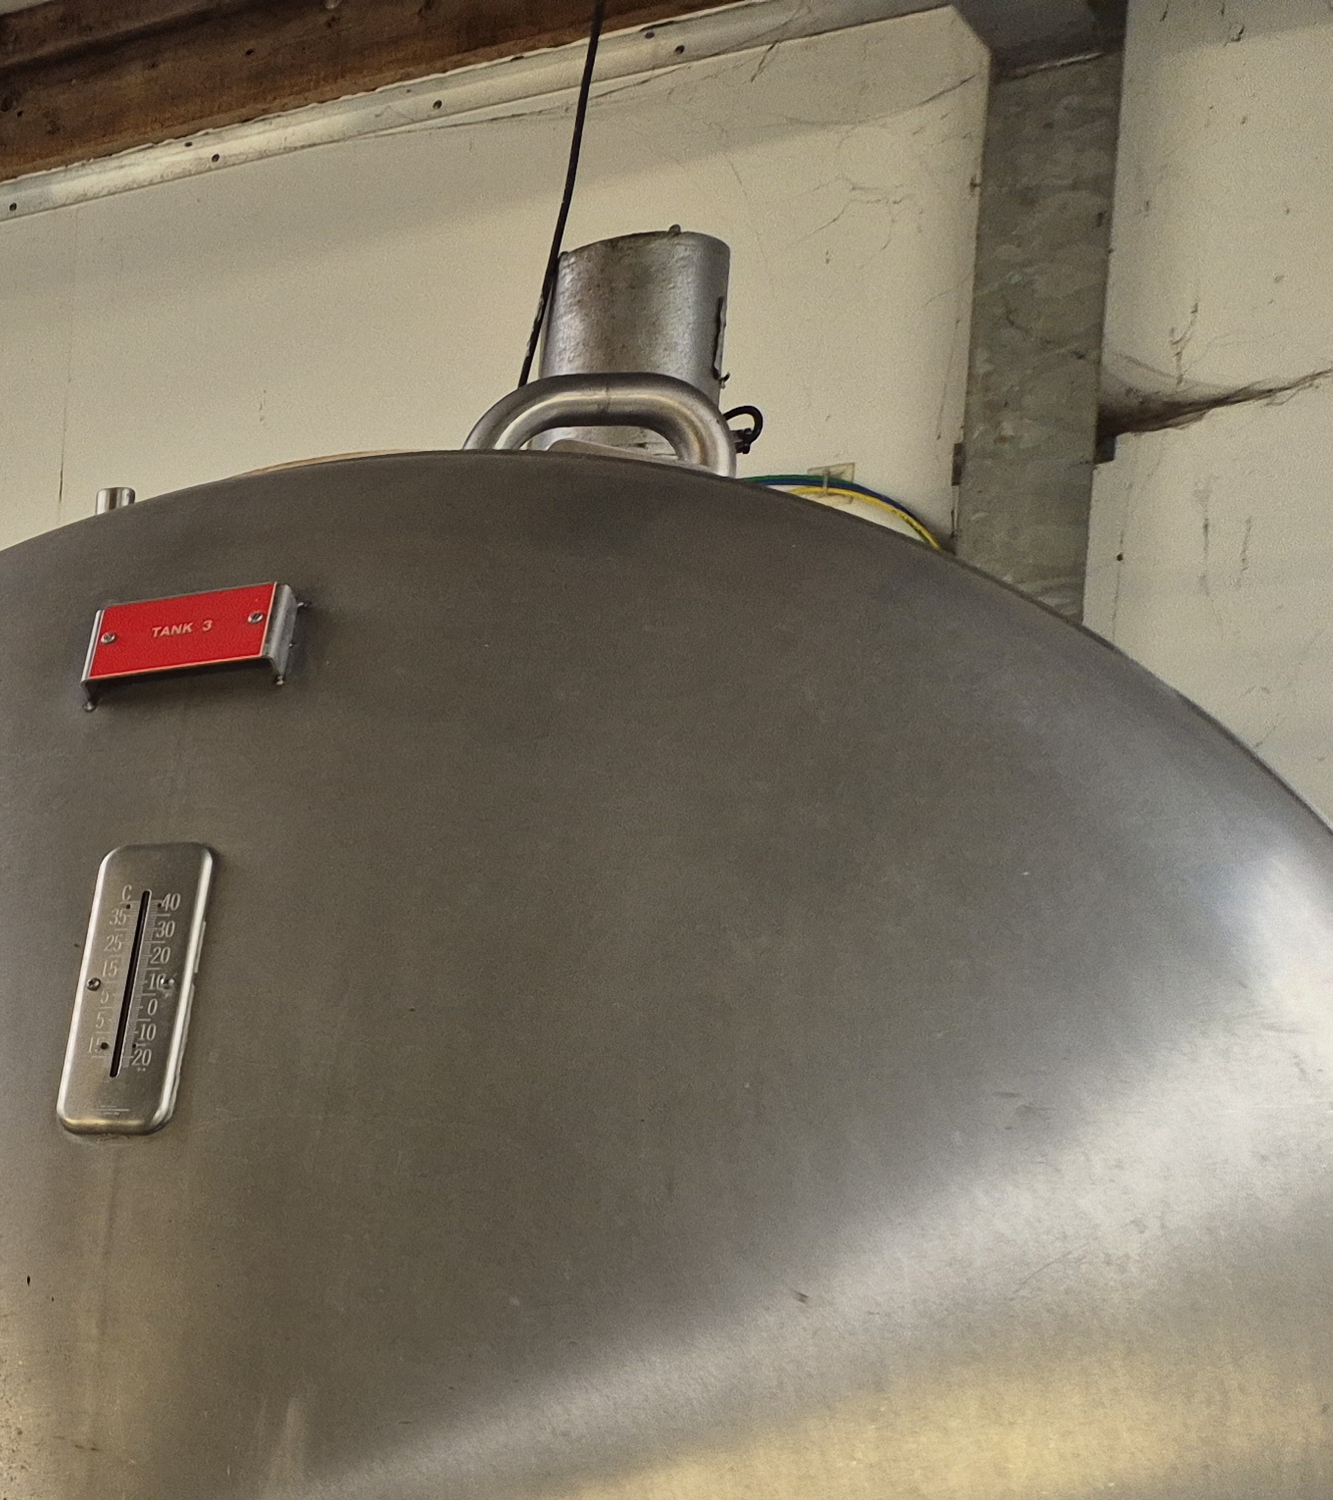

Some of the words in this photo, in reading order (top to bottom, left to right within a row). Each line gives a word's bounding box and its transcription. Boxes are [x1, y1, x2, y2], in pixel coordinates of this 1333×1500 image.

[151, 622, 194, 638] TANK
[201, 619, 214, 632] 3
[121, 884, 133, 901] C
[161, 893, 181, 911] 40
[109, 909, 127, 925] 35
[155, 920, 176, 938] 30
[103, 934, 123, 952] 25
[149, 946, 171, 964] 20
[102, 960, 118, 977] 15
[147, 998, 158, 1016] 0
[95, 1011, 106, 1029] 5
[131, 1048, 152, 1067] 20
